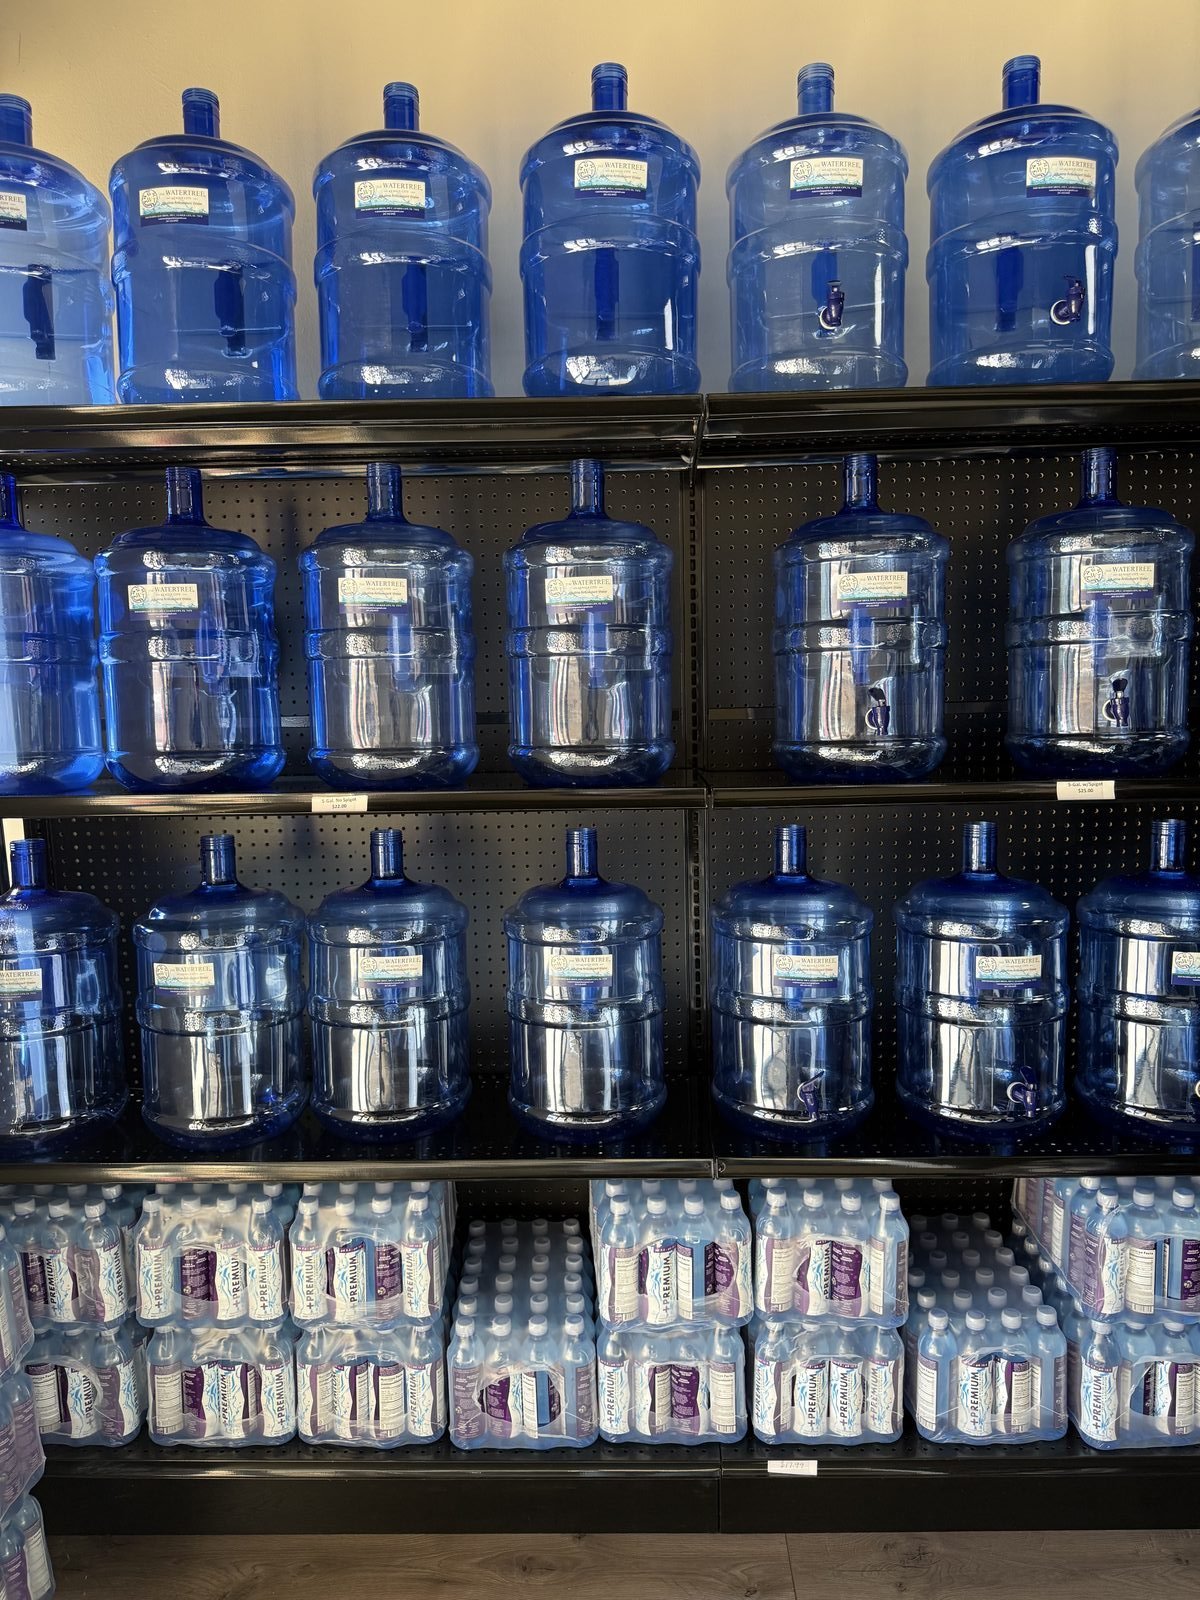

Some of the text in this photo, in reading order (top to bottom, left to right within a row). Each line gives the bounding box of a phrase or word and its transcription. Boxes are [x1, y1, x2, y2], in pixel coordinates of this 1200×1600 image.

[605, 162, 643, 170] WATERTREE
[1058, 160, 1093, 169] WATERTREE
[383, 182, 421, 190] WATERTREE
[165, 189, 204, 197] WATERTREE
[1112, 565, 1150, 573] WATERTREE
[867, 573, 904, 581] WATERTREE
[385, 957, 419, 965] WATERTREE
[1004, 956, 1038, 965] WATERTREE
